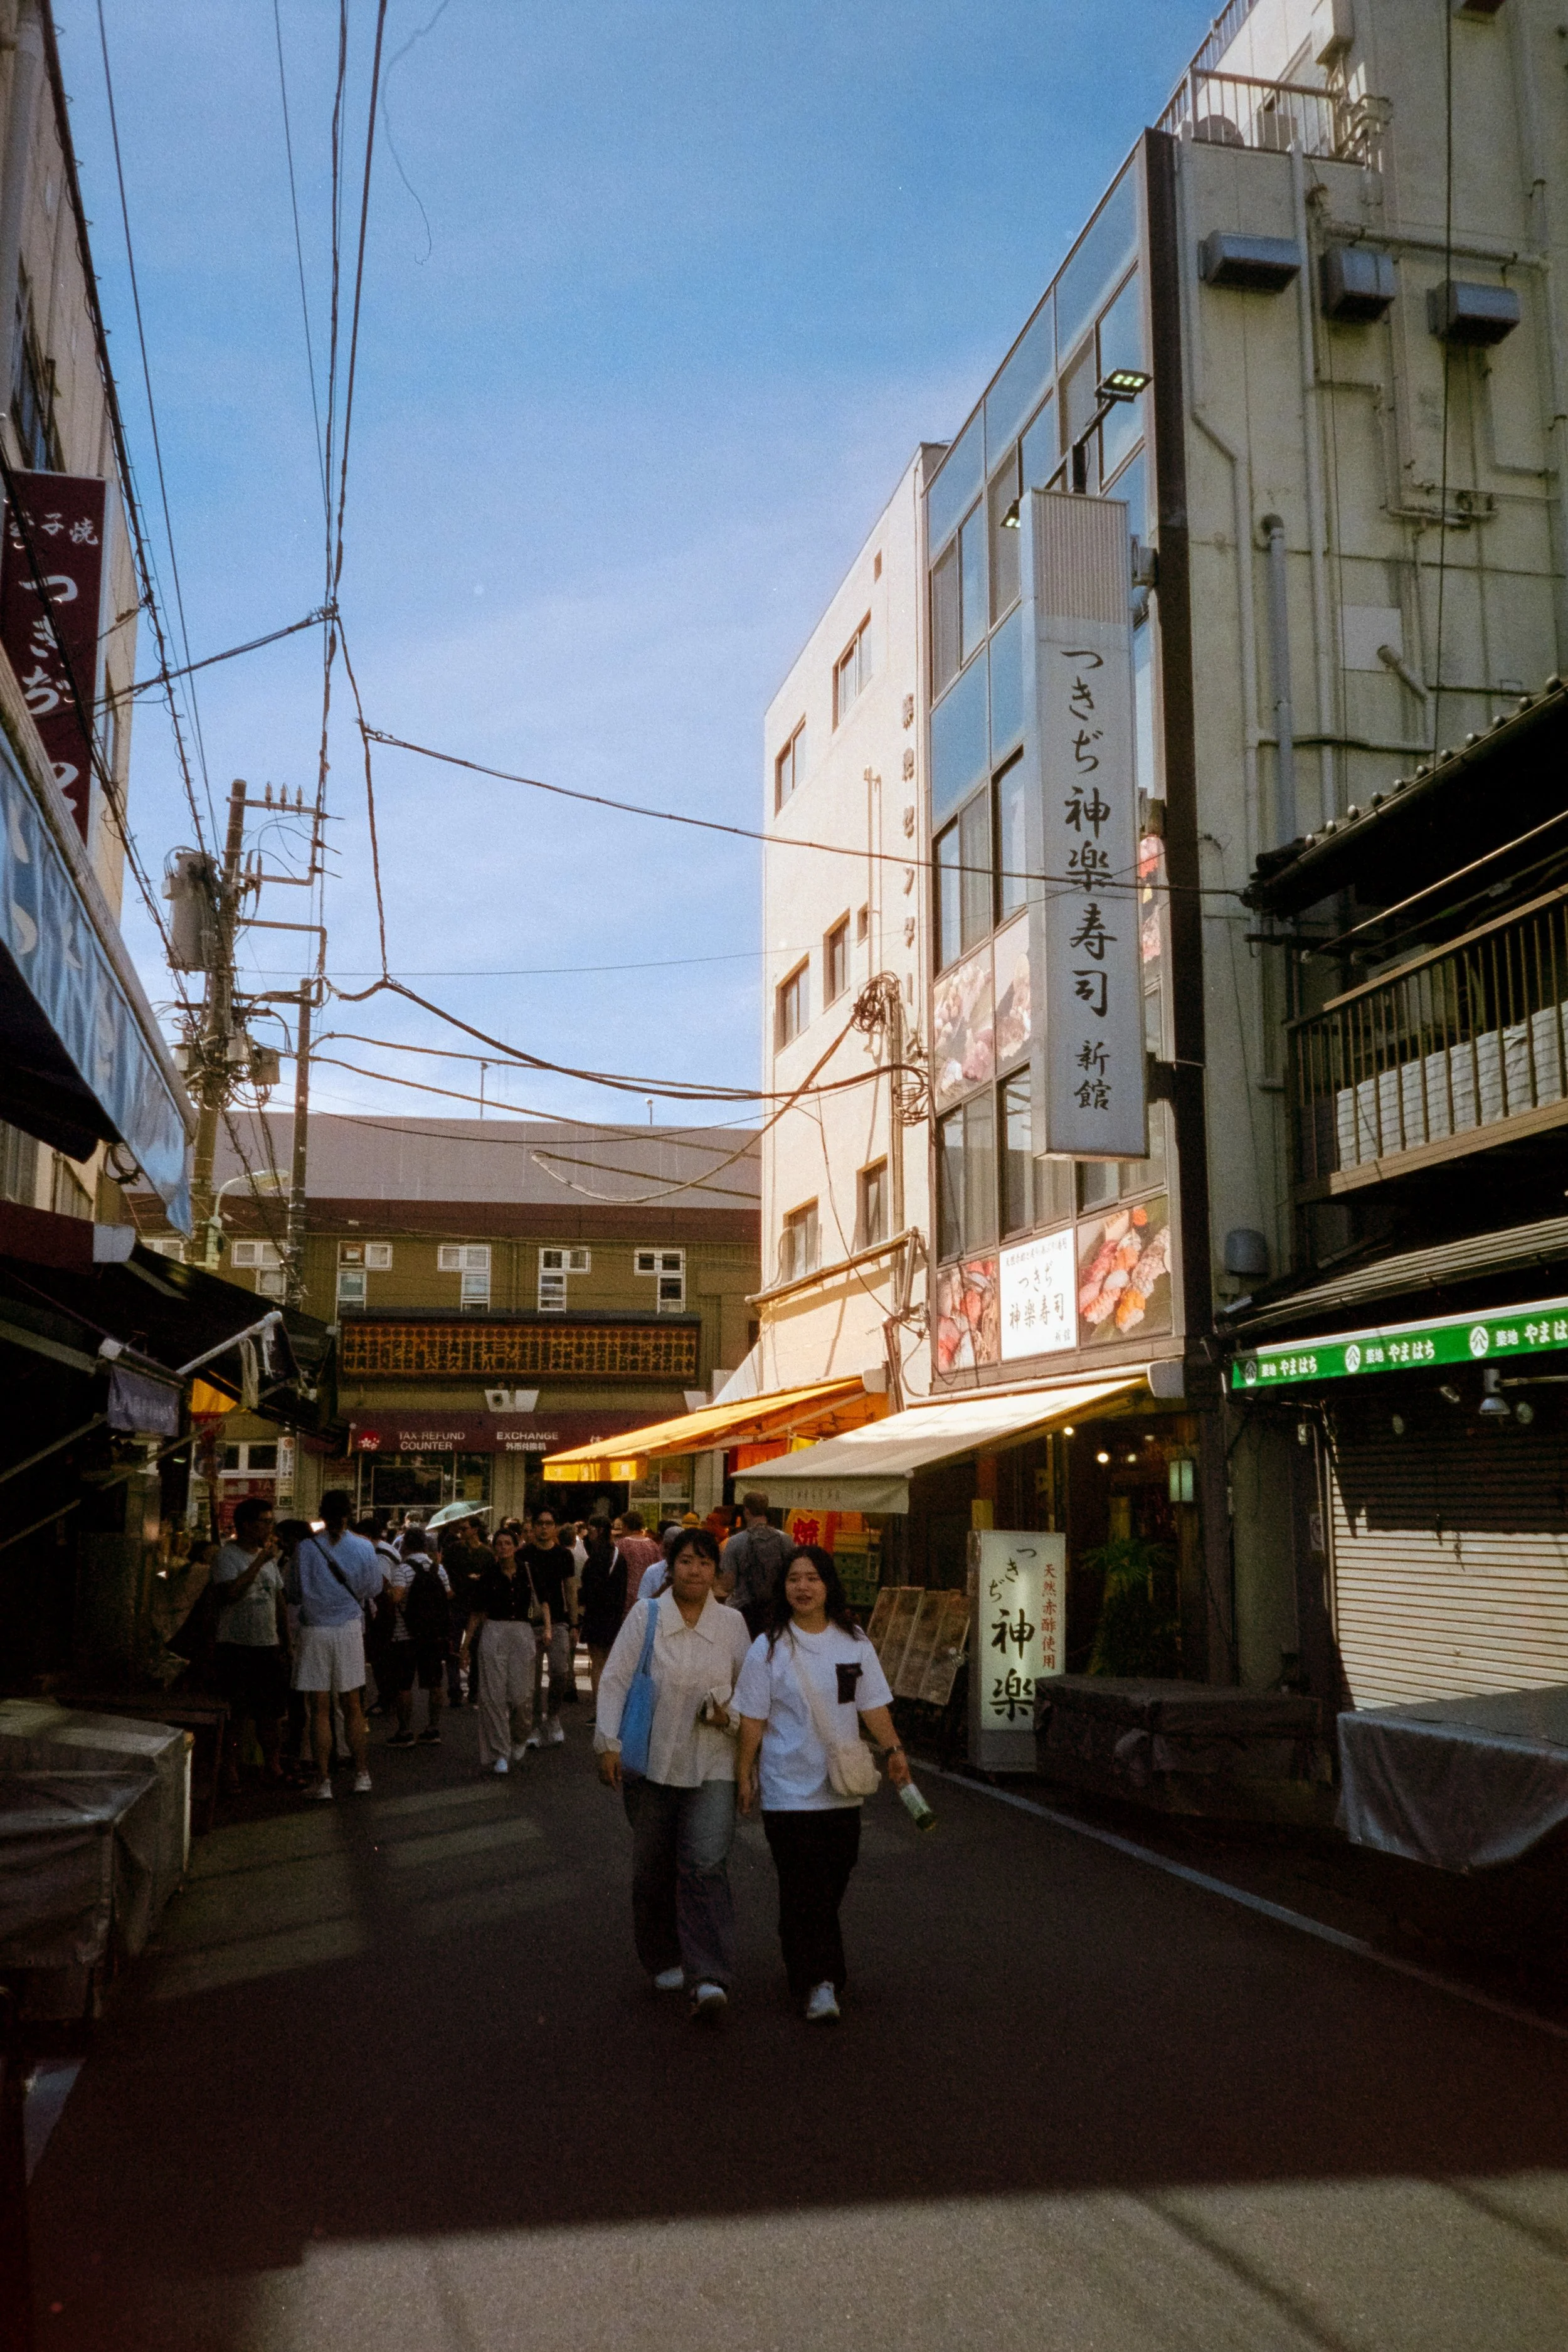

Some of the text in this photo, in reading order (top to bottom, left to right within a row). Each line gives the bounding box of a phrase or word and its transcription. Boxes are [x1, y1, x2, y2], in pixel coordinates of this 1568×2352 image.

[1060, 650, 1117, 1111] つきぢ神楽寿司 新館
[1019, 1261, 1054, 1292] つきぢ
[1009, 1293, 1064, 1332] 神楽寿司
[1496, 1329, 1518, 1347] 築地
[1279, 1355, 1317, 1376] やまはち
[1366, 1340, 1435, 1364] 築地 やまはち
[400, 1441, 453, 1451] COUNTER
[421, 1431, 465, 1440] REFUND
[497, 1432, 559, 1440] EXCHANGE
[988, 1547, 1037, 1603] つきぢ
[1041, 1563, 1057, 1670] 天然赤酢使用
[989, 1608, 1036, 1722] 神楽
